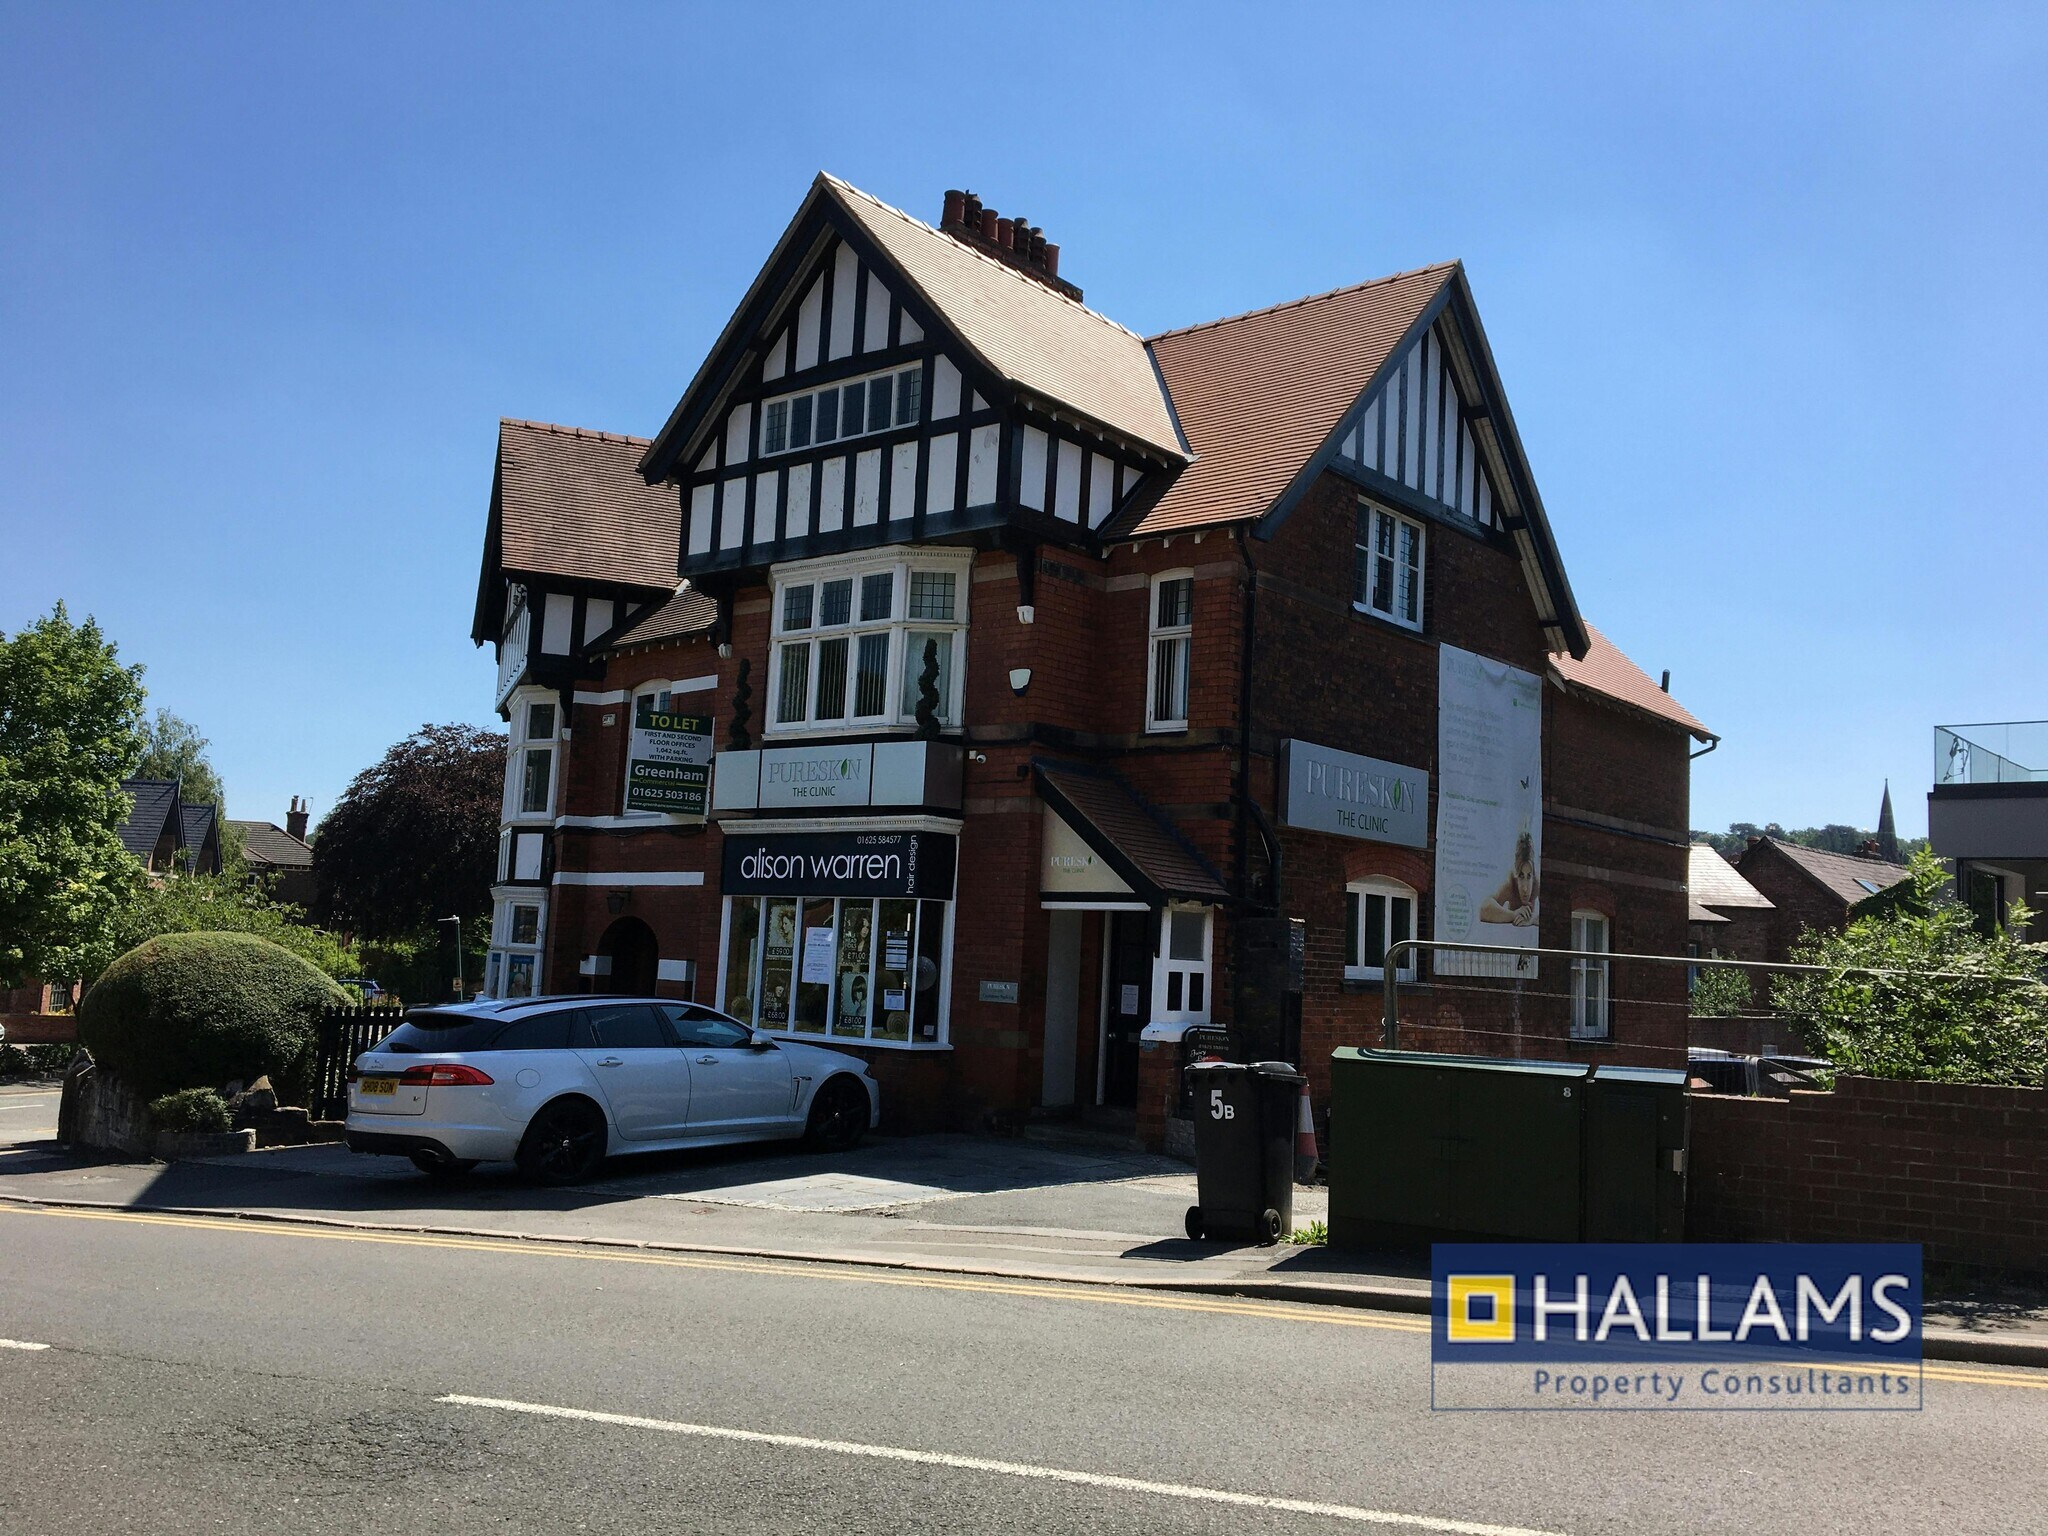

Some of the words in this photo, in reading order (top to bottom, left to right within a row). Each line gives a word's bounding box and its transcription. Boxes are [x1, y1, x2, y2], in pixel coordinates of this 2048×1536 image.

[650, 714, 670, 728] TO
[673, 716, 700, 731] LET
[677, 734, 702, 742] SECOND
[634, 764, 704, 781] Greenham
[639, 777, 676, 786] Commercial
[632, 787, 664, 798] 01625
[665, 790, 702, 801] 503186
[792, 786, 808, 798] THE
[809, 785, 836, 797] CLINIC
[1337, 810, 1356, 828] THE
[1358, 814, 1389, 834] CLINIC
[856, 836, 876, 845] 01625
[878, 835, 902, 844] 584577
[906, 834, 919, 870] design
[740, 846, 804, 880] alison
[810, 854, 900, 880] warren
[906, 872, 915, 894] hair
[1562, 1086, 1572, 1098] 8
